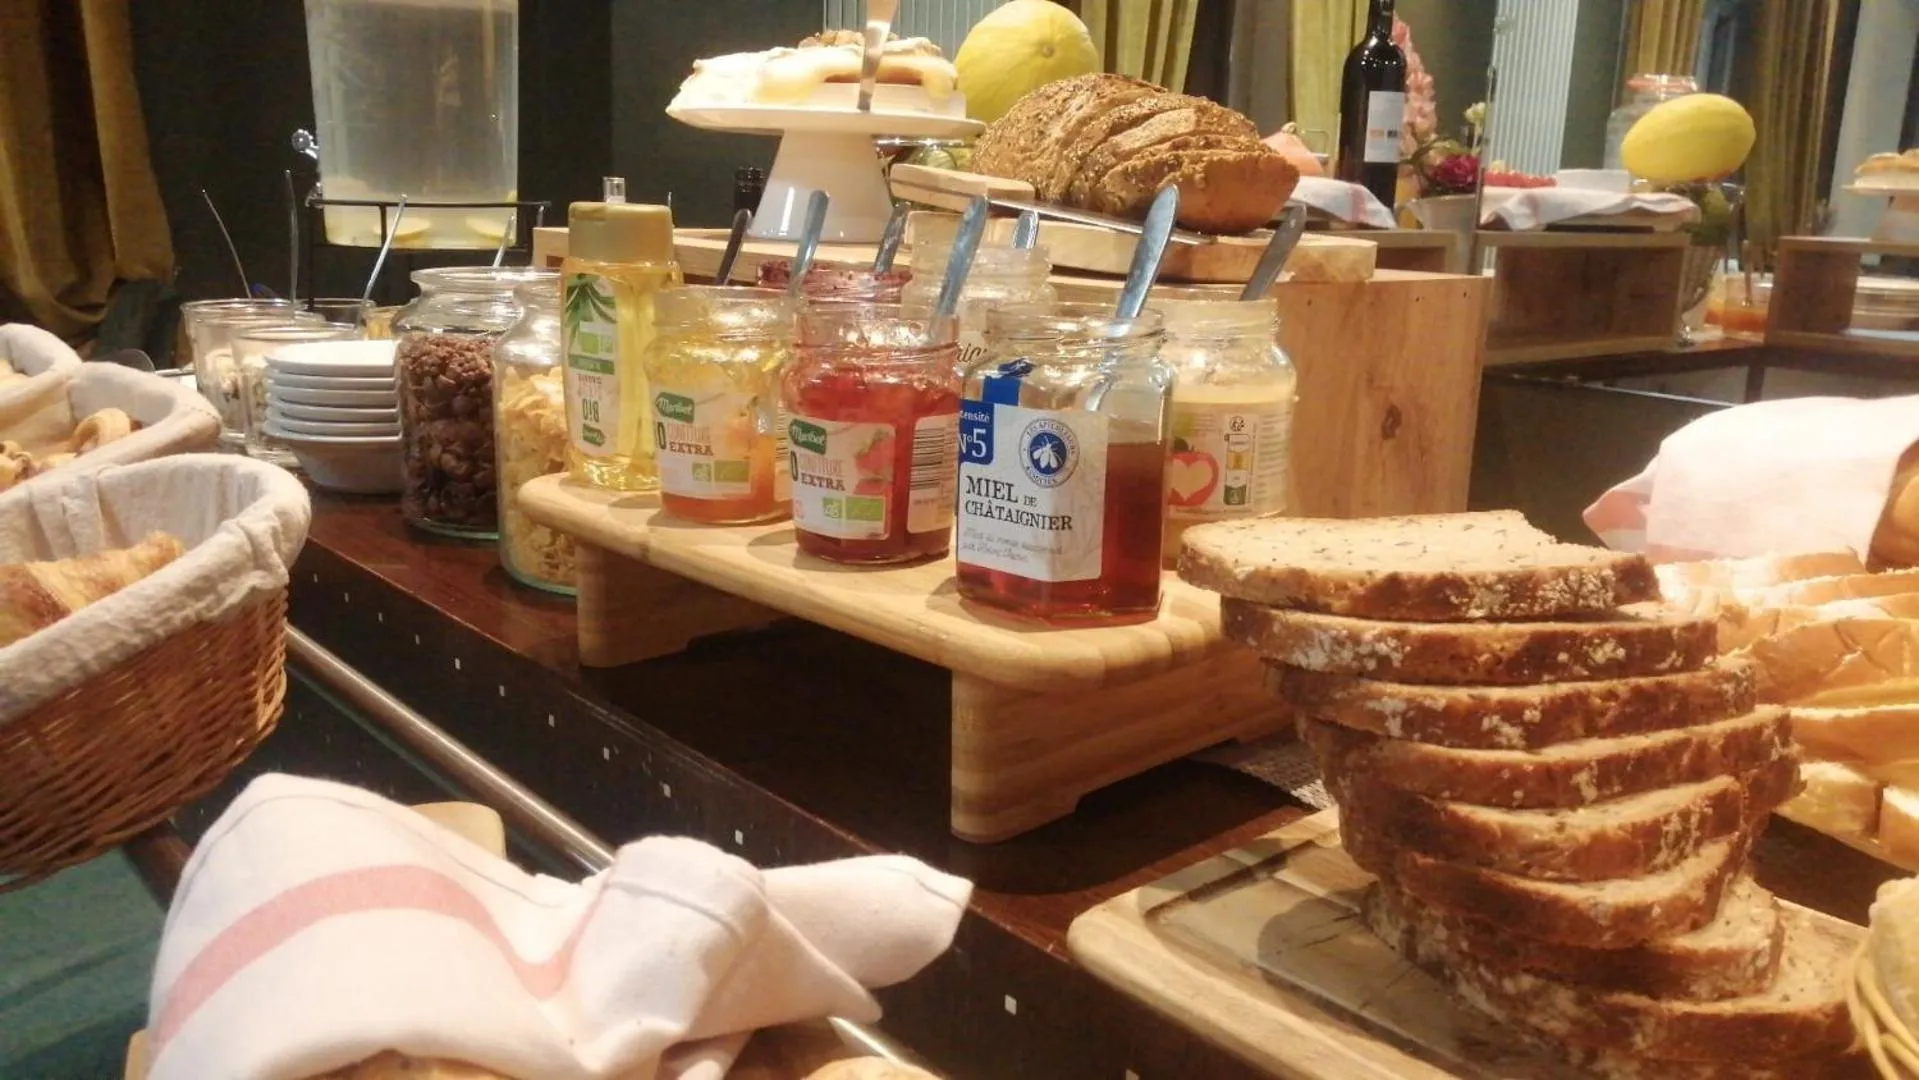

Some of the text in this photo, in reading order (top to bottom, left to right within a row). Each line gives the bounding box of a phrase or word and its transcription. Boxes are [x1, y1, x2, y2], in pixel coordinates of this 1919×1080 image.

[670, 441, 714, 457] EXTRA
[800, 473, 846, 491] EXTRA
[965, 476, 1019, 504] MIEL
[1023, 495, 1038, 508] DE
[965, 499, 1073, 531] CHÂTAIGNIER
